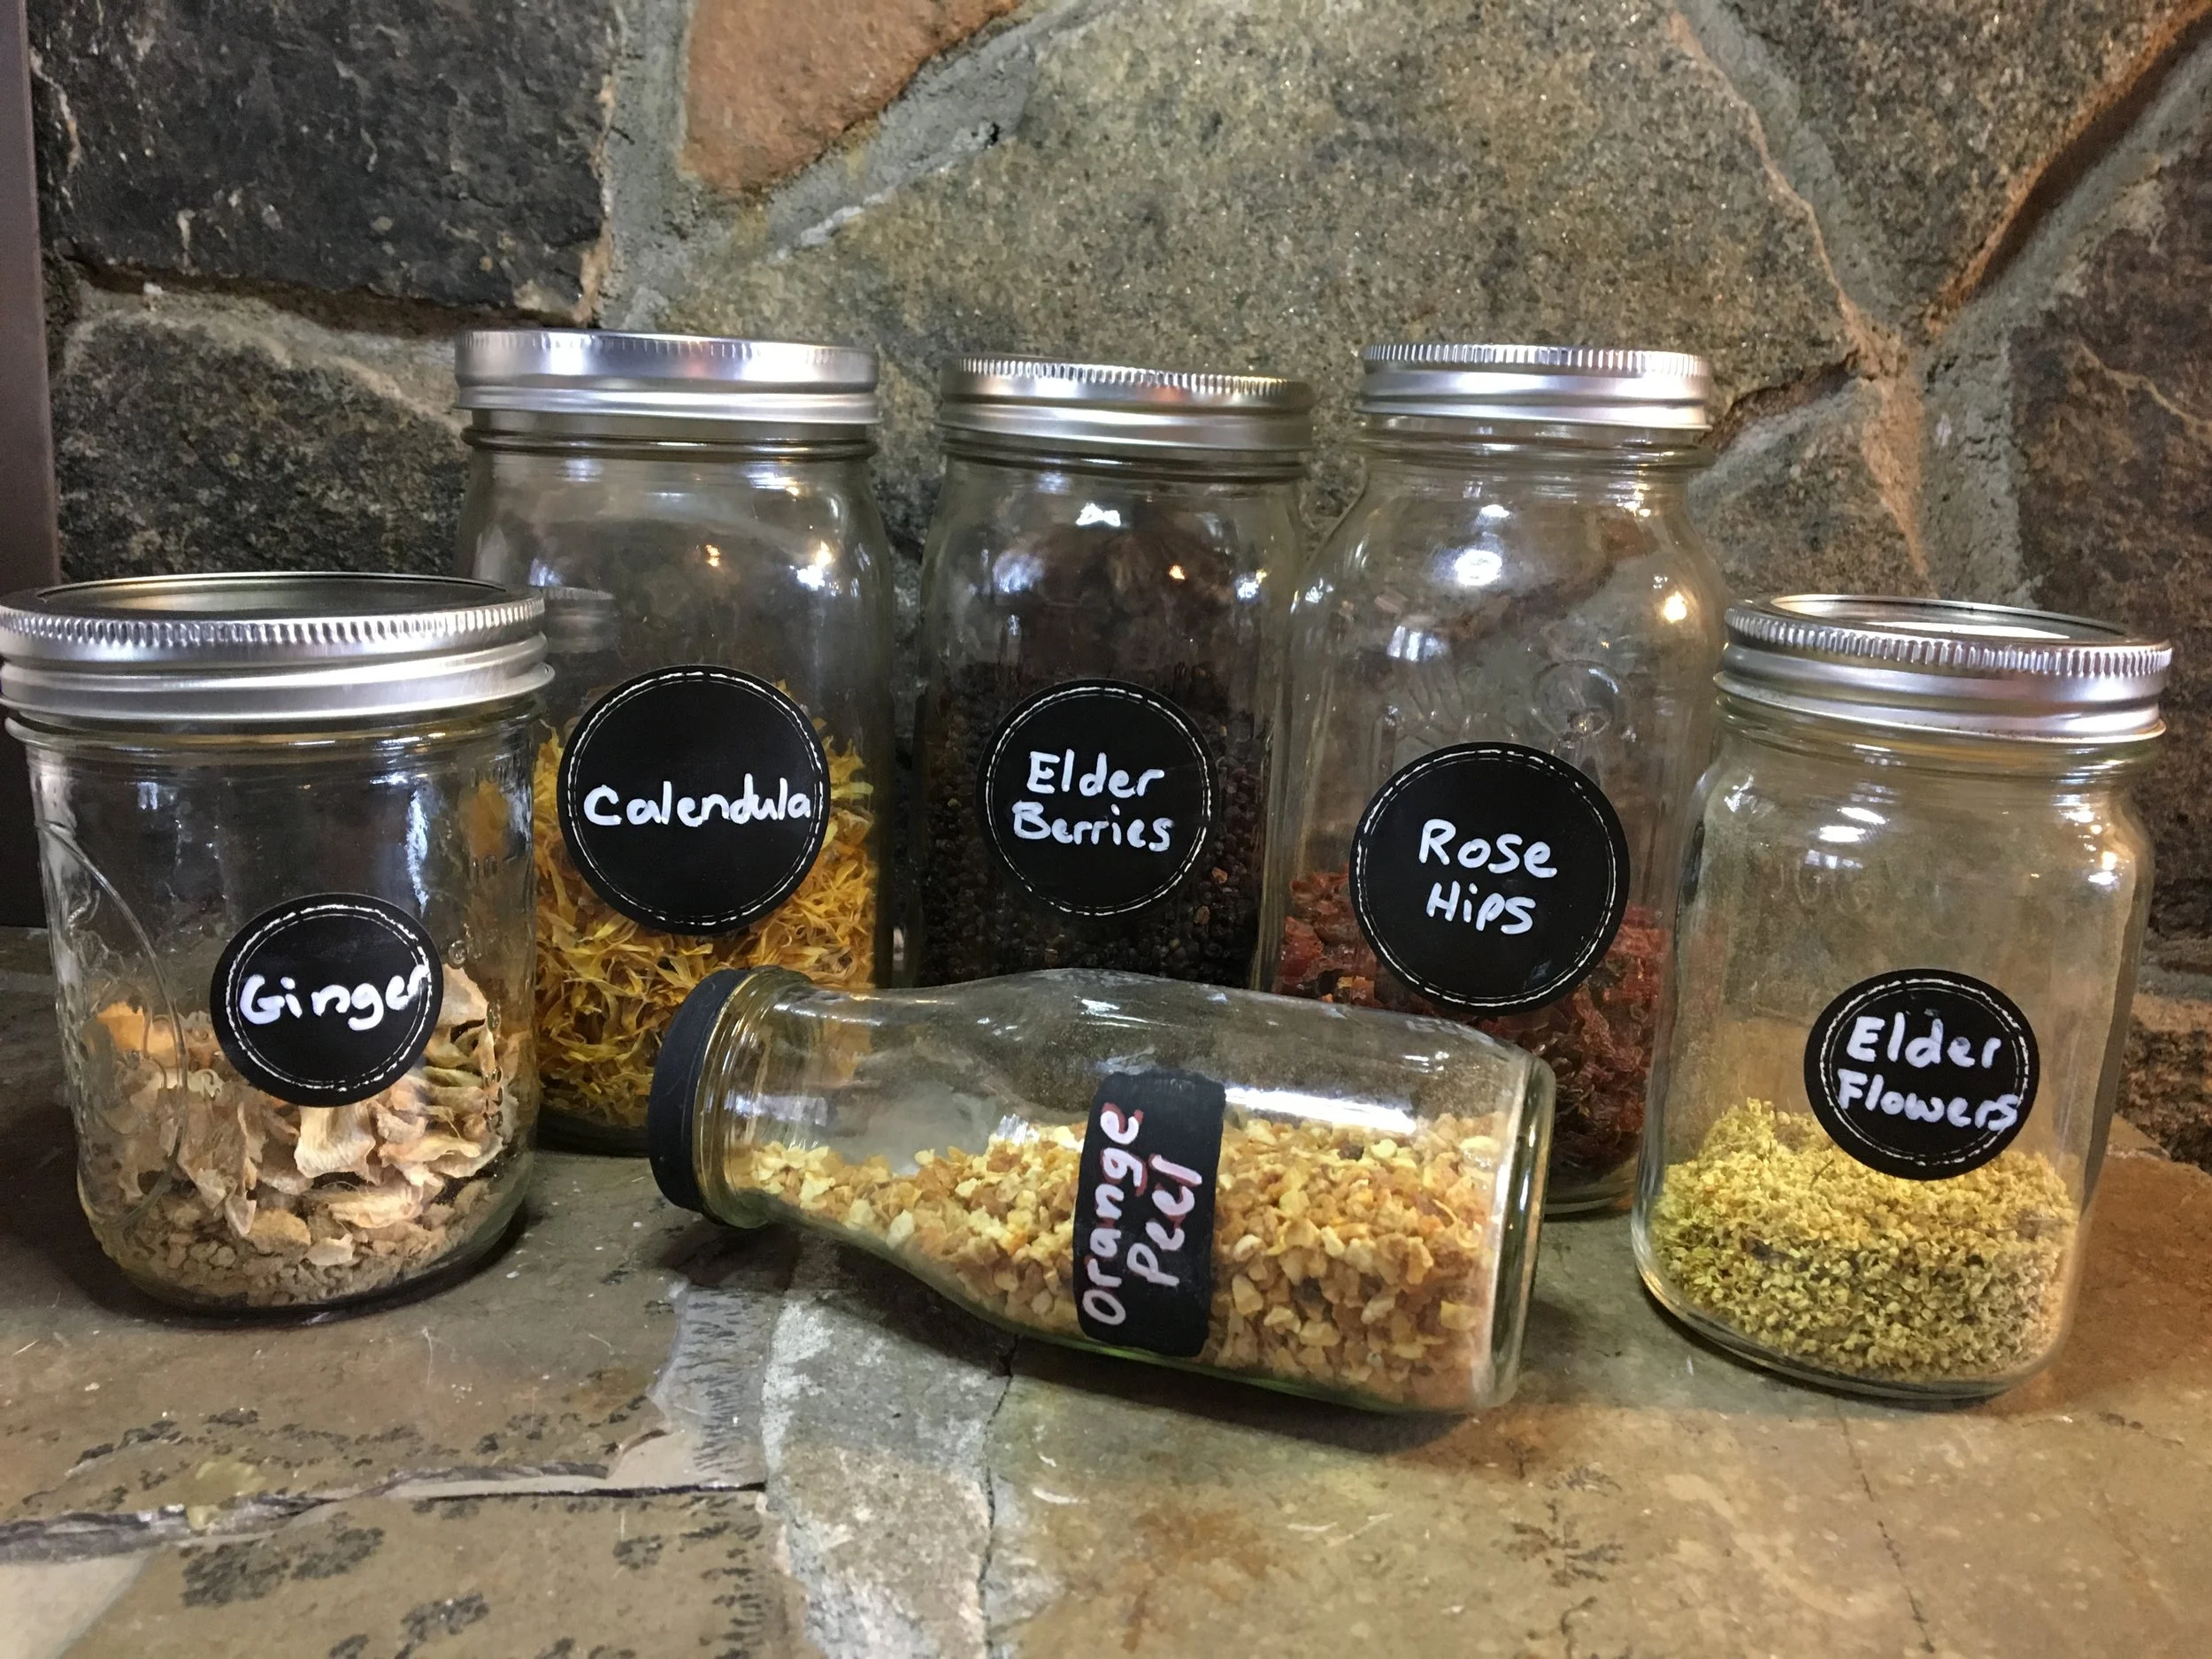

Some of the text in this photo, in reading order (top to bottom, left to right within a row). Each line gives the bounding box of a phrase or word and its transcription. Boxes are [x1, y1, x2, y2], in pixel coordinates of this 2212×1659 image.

[583, 772, 811, 827] Calendula
[1026, 749, 1165, 798] Elder
[1011, 800, 1175, 852] Berries
[1418, 818, 1557, 878] Rose
[1426, 880, 1537, 934] Hips
[239, 964, 431, 1032] Ginger
[1846, 1011, 2002, 1069] Elder
[1837, 1068, 2020, 1132] Flowers
[1081, 1102, 1148, 1325] Orange
[1125, 1152, 1203, 1286] Peel
